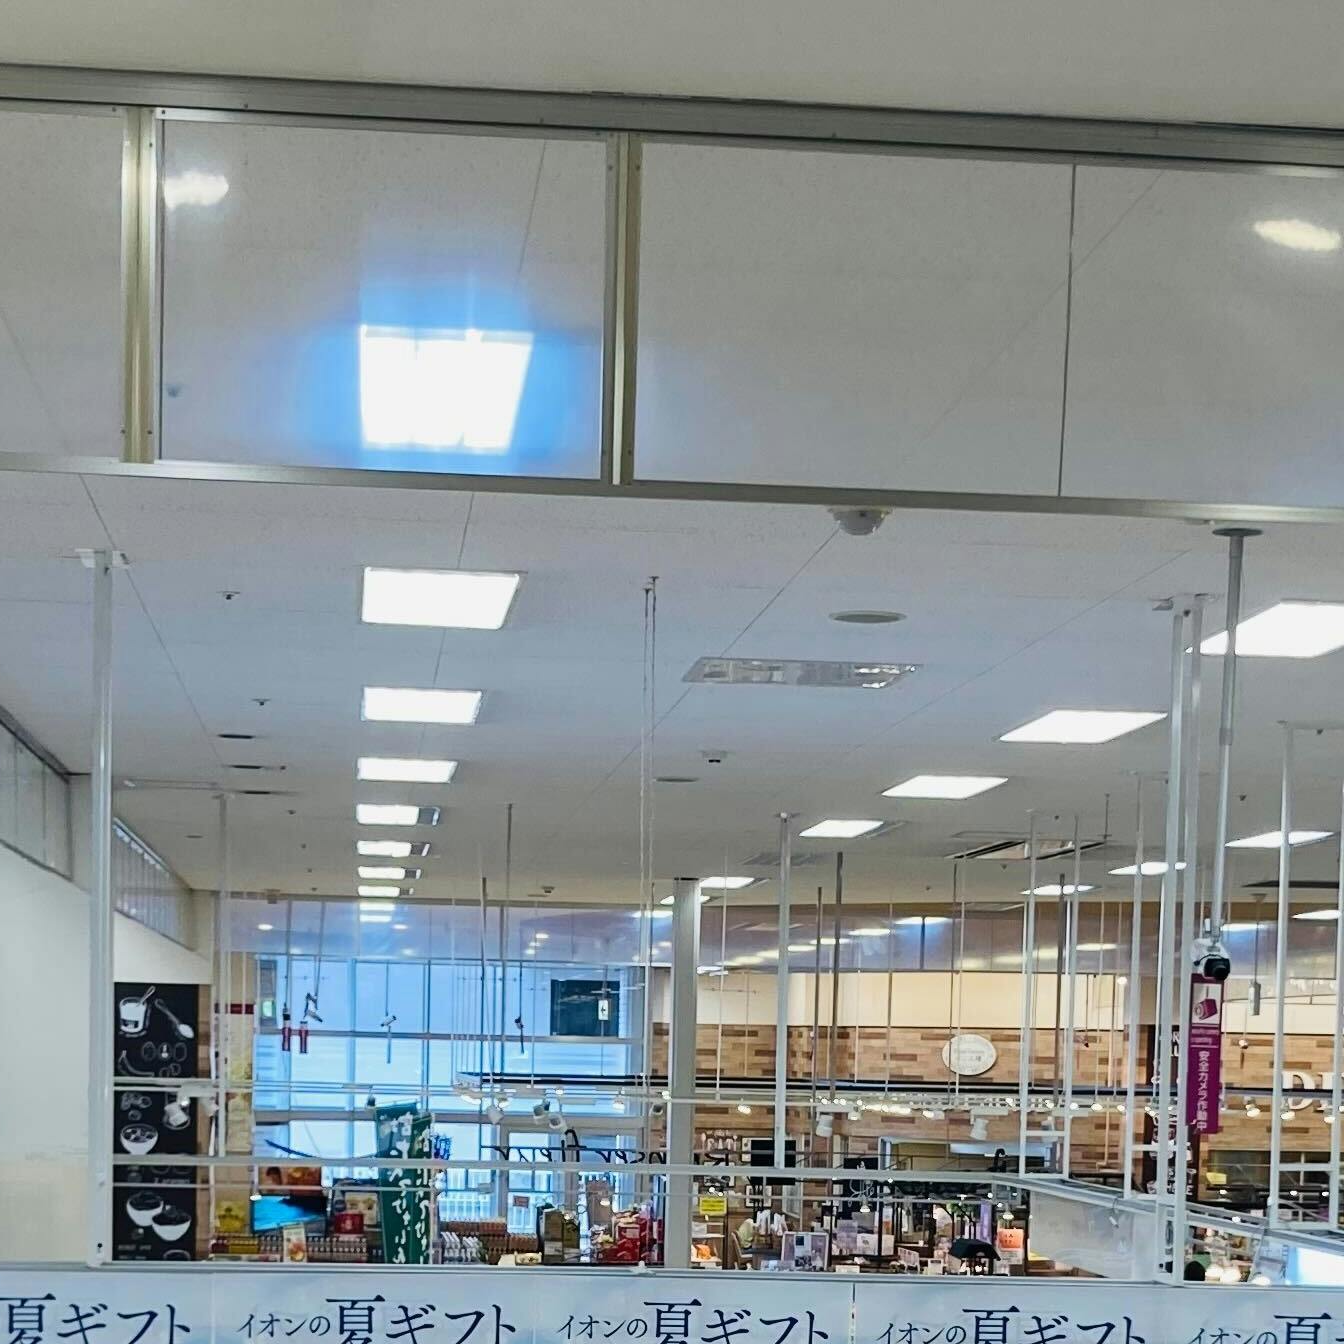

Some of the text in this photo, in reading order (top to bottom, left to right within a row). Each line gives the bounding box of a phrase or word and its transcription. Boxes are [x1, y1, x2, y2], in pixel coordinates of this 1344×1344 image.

[1197, 1050, 1210, 1130] 安全カメラ作動中
